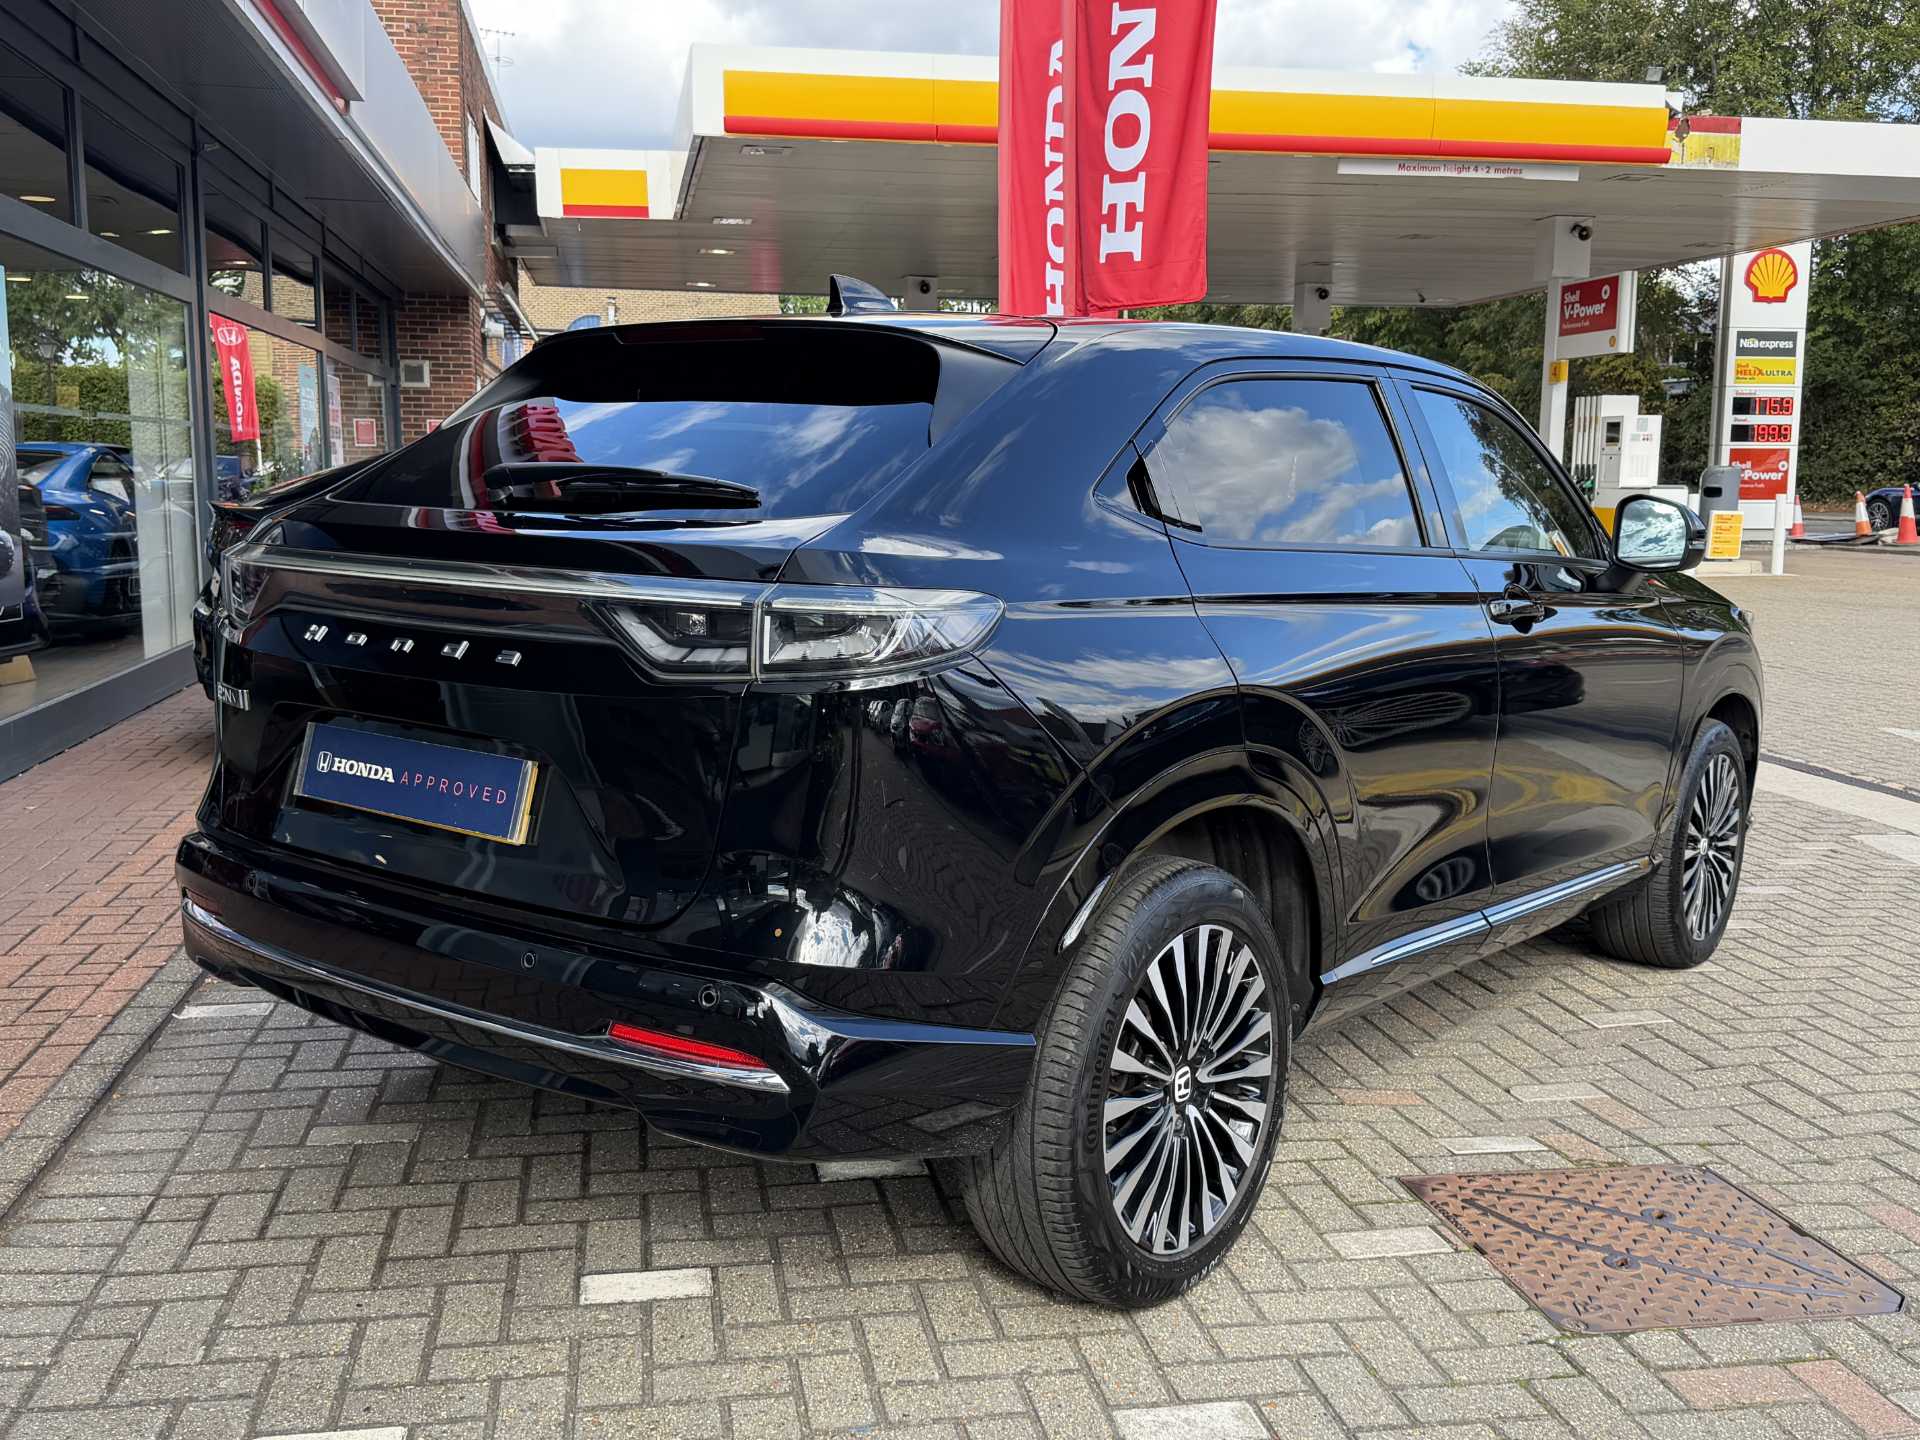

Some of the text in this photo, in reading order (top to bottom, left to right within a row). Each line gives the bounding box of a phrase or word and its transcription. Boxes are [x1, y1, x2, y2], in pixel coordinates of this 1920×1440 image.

[1397, 162, 1441, 173] Maximum
[1493, 166, 1523, 175] metres
[1564, 290, 1580, 303] Shell
[1765, 369, 1793, 377] ULTRA
[1755, 397, 1794, 415] 175.9
[1753, 424, 1792, 442] 199.9
[332, 756, 507, 805] HONDA APPROVED
[1085, 1010, 1119, 1155] Continental
